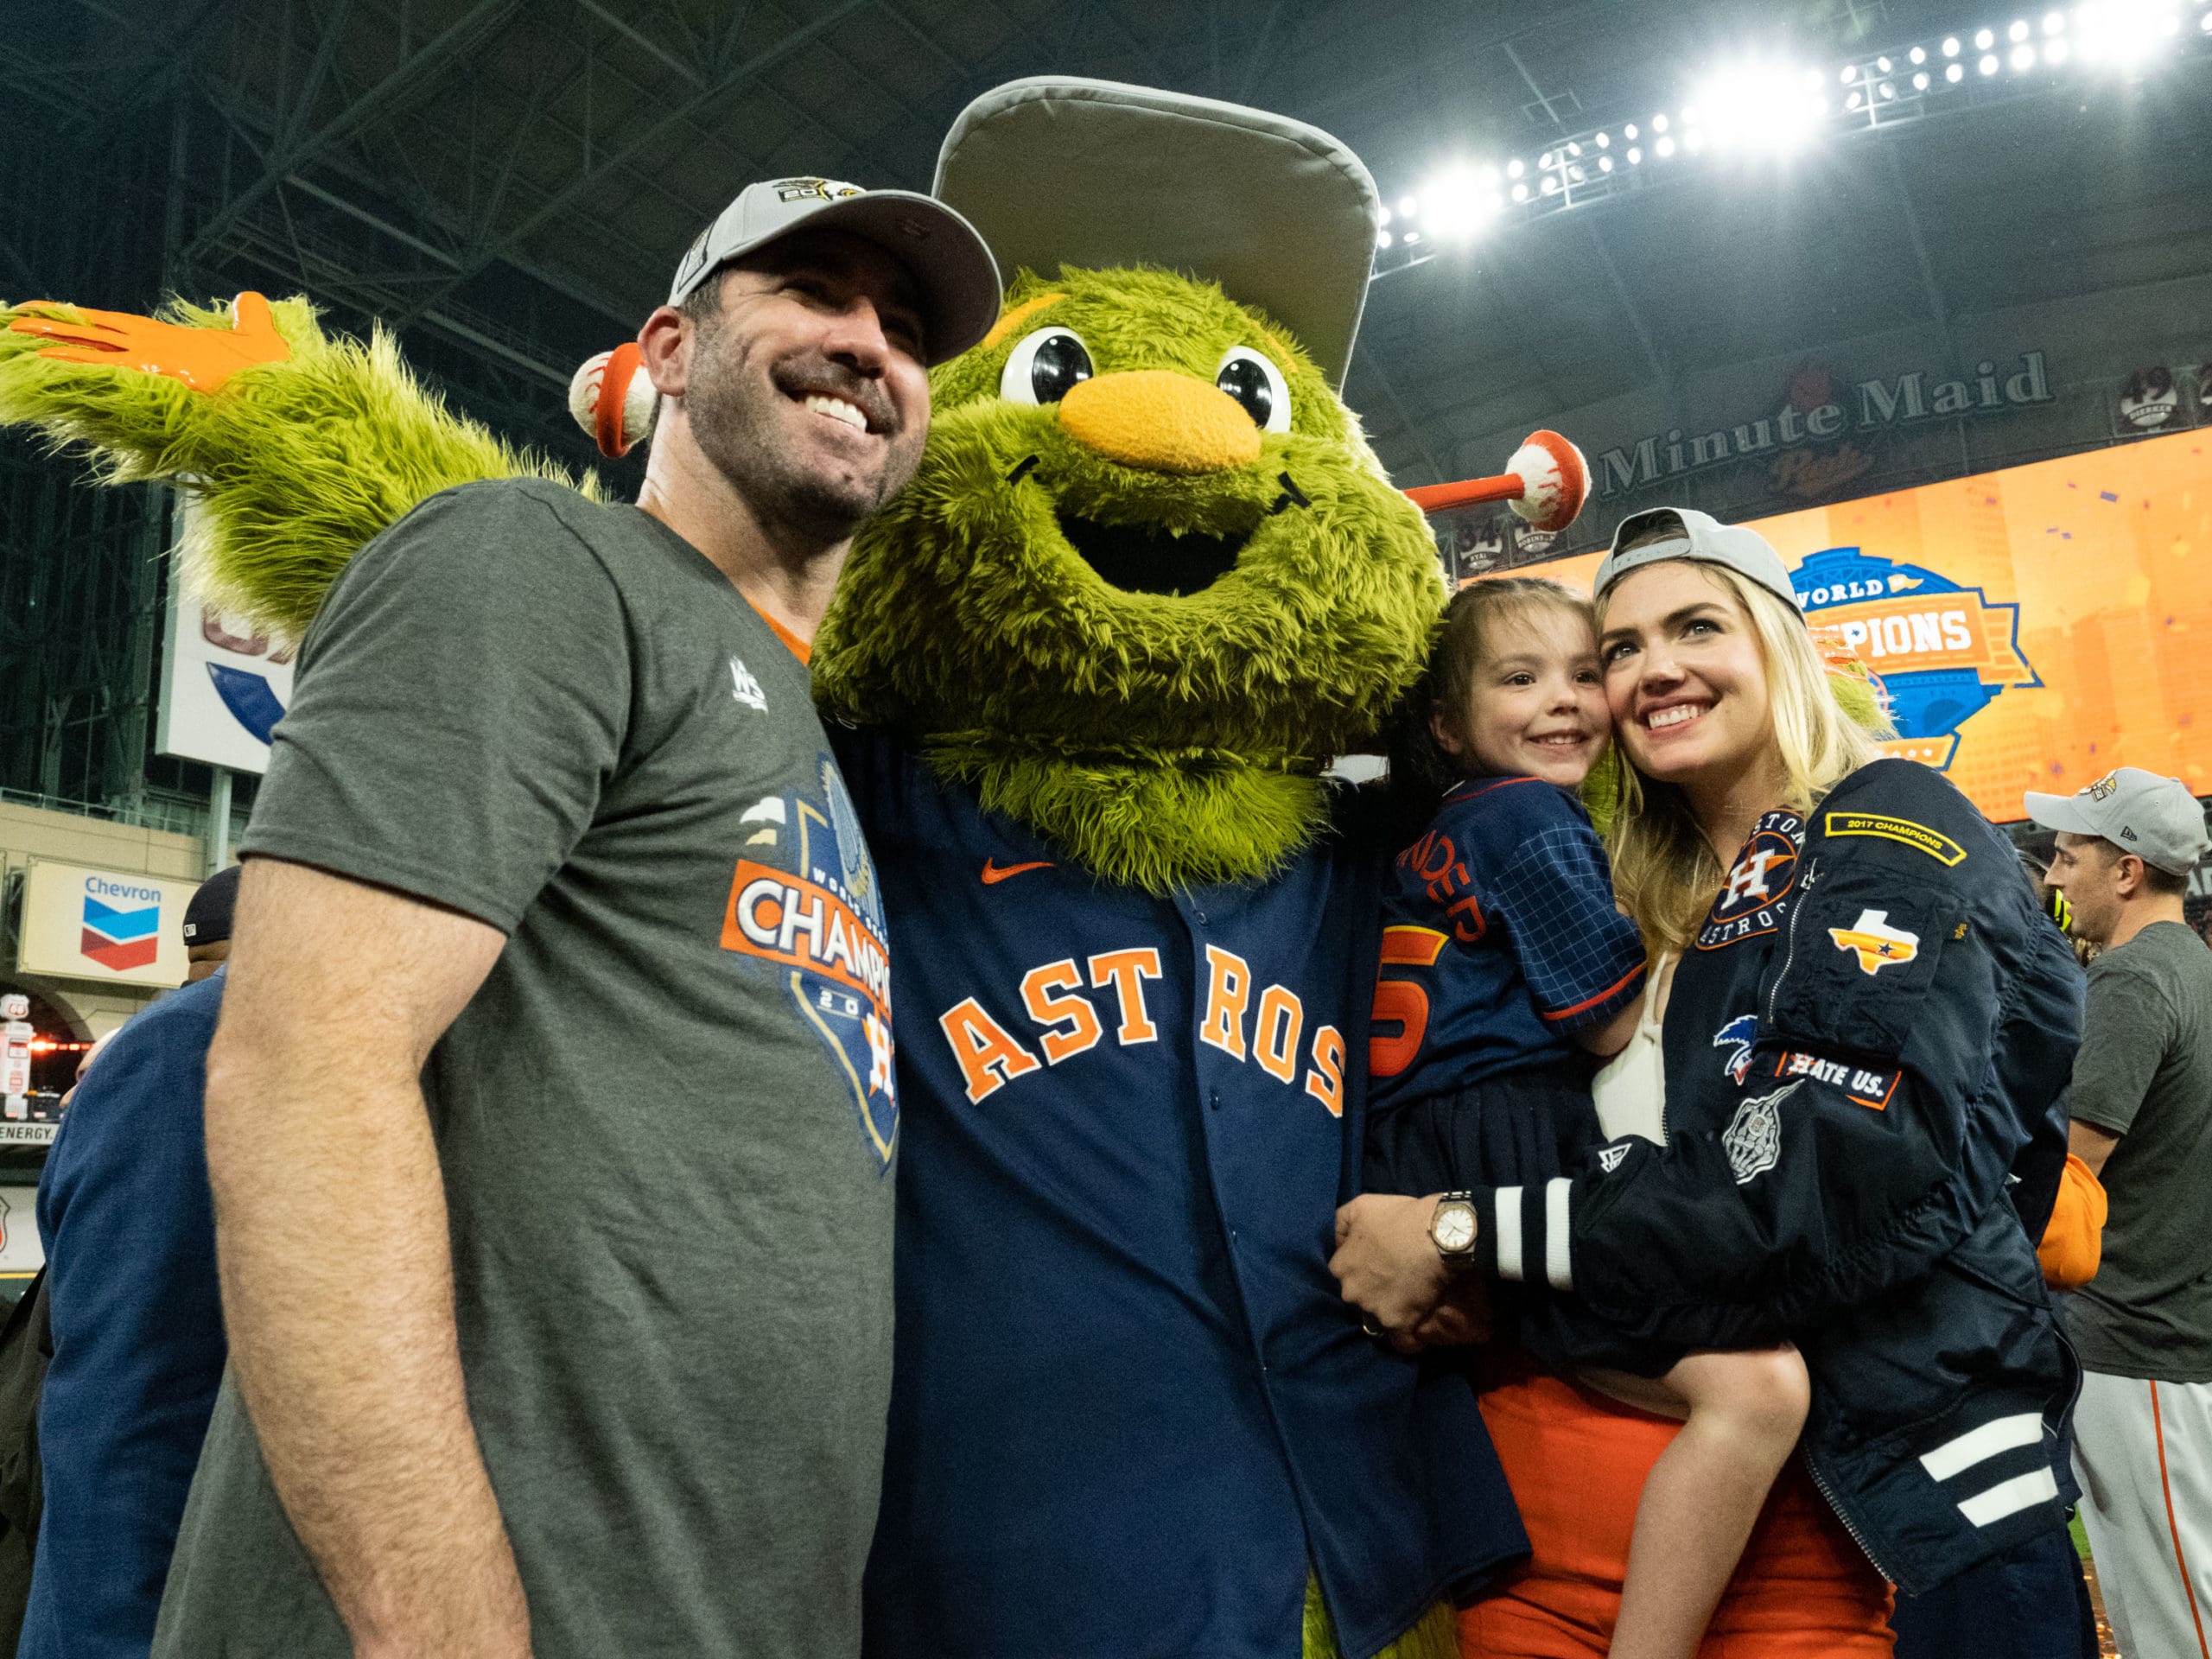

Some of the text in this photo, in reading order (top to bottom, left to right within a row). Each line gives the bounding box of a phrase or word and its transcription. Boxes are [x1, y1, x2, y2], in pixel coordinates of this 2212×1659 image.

[1599, 351, 2055, 497] Minute Maid
[1847, 820, 1943, 850] 2017 CHAMPIONS
[85, 876, 162, 902] Chevron
[938, 943, 1347, 1119] ASTROS
[1788, 1052, 1850, 1086] HATE
[1850, 1069, 1885, 1097] US.
